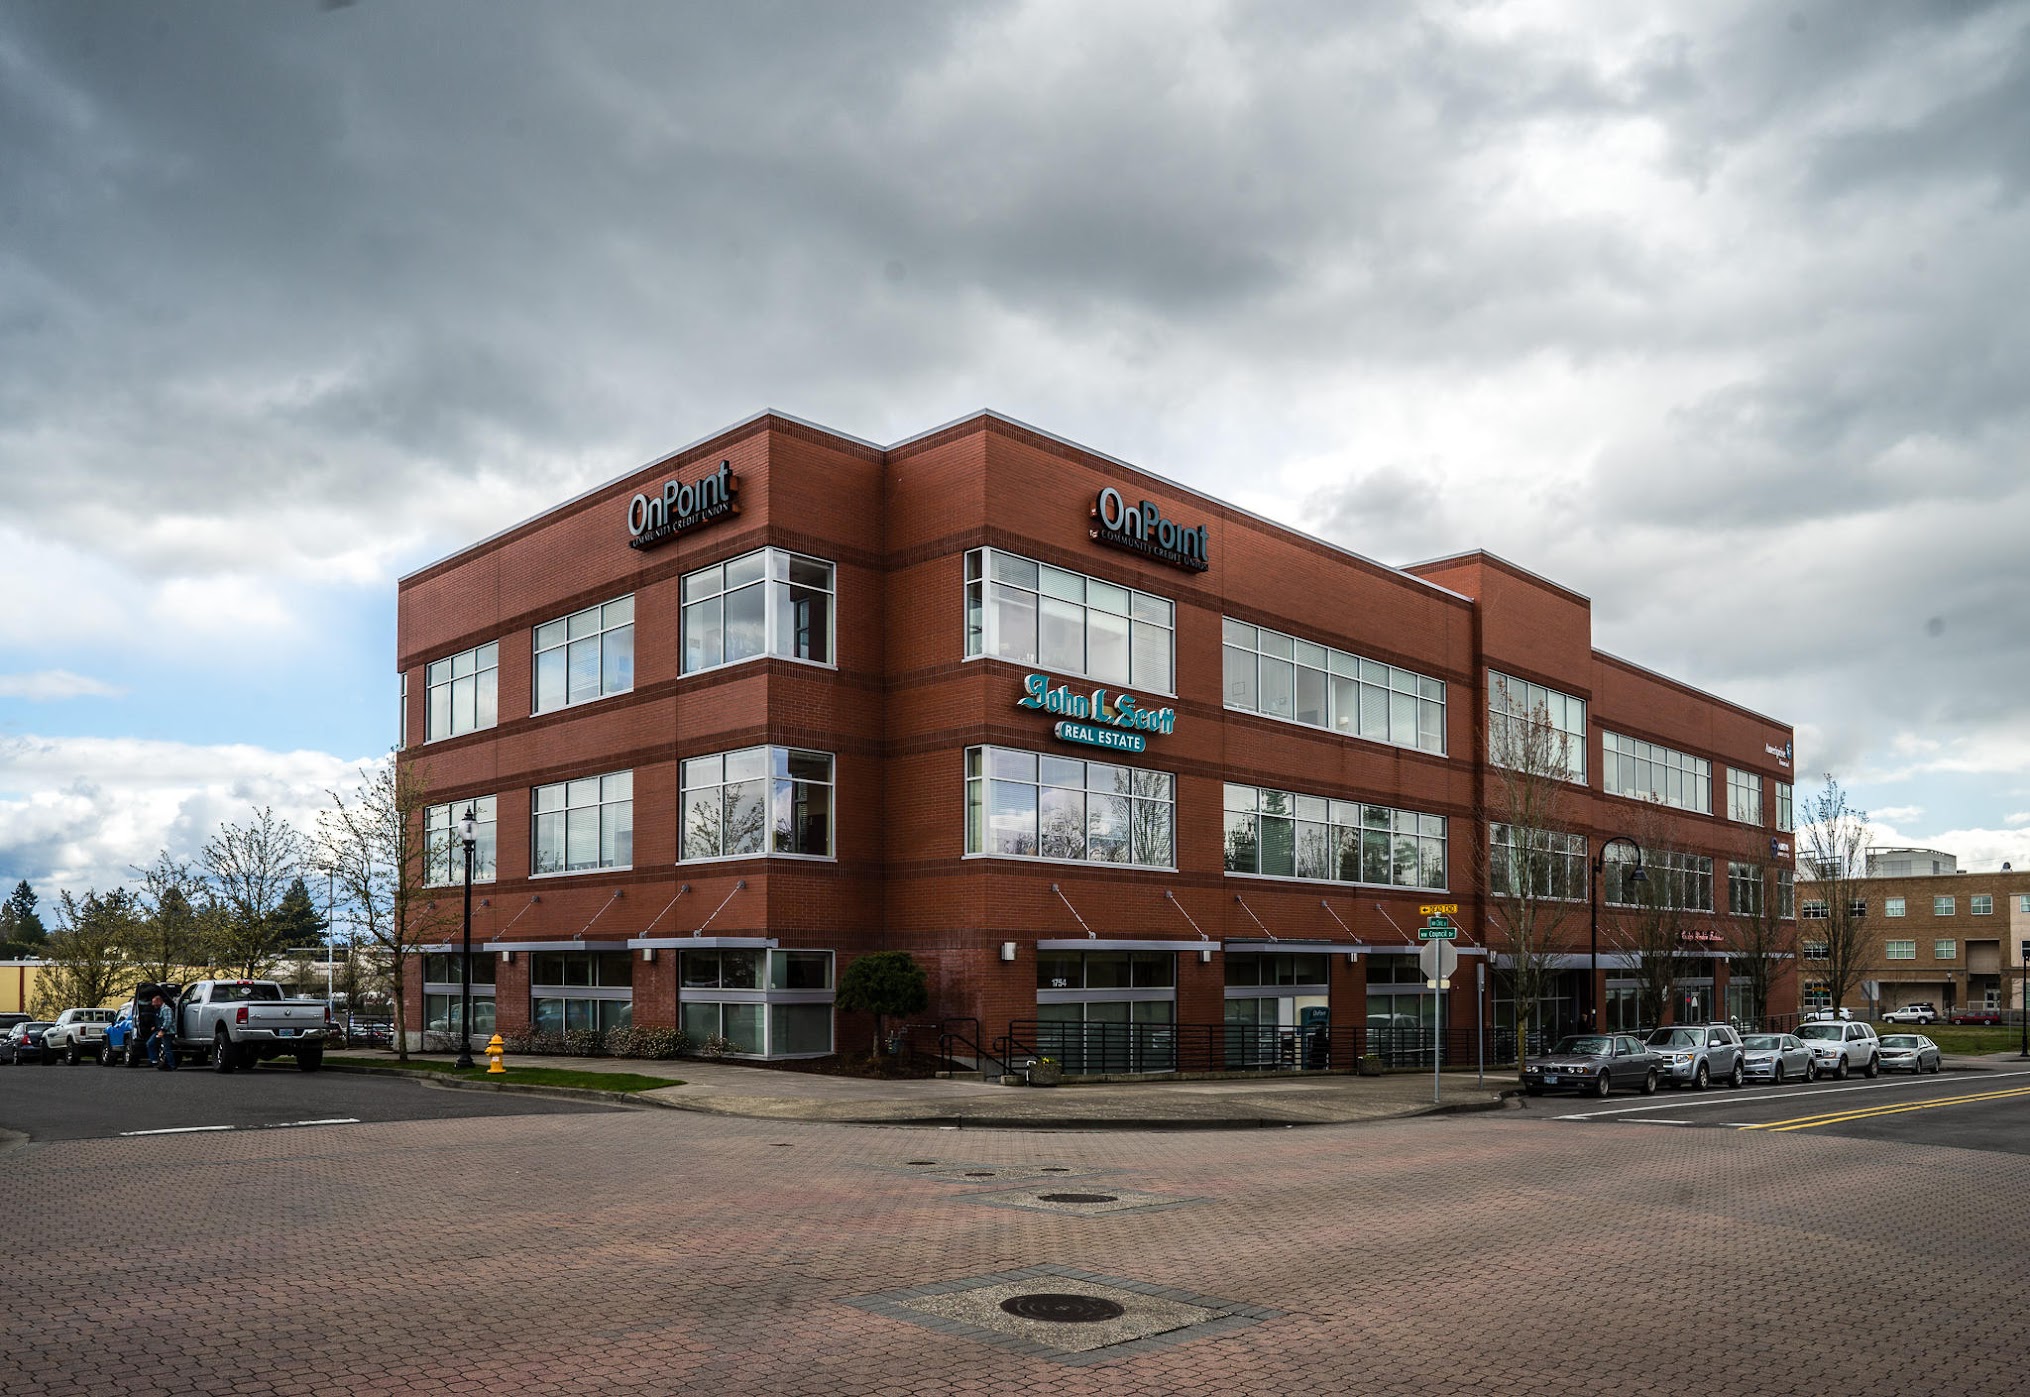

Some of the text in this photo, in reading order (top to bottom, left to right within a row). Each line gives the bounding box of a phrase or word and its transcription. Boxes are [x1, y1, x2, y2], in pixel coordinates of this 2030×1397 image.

[628, 460, 730, 536] OnPoint
[673, 513, 699, 531] CREDIT
[701, 502, 730, 520] UNION
[1100, 487, 1209, 562] OnPoint
[1101, 529, 1152, 554] COMMUNITY
[1154, 547, 1182, 564] CREDIT
[1017, 674, 1176, 734] John L. Scott
[1065, 724, 1140, 749] REAL ESTATE
[1051, 978, 1067, 987] 1754
